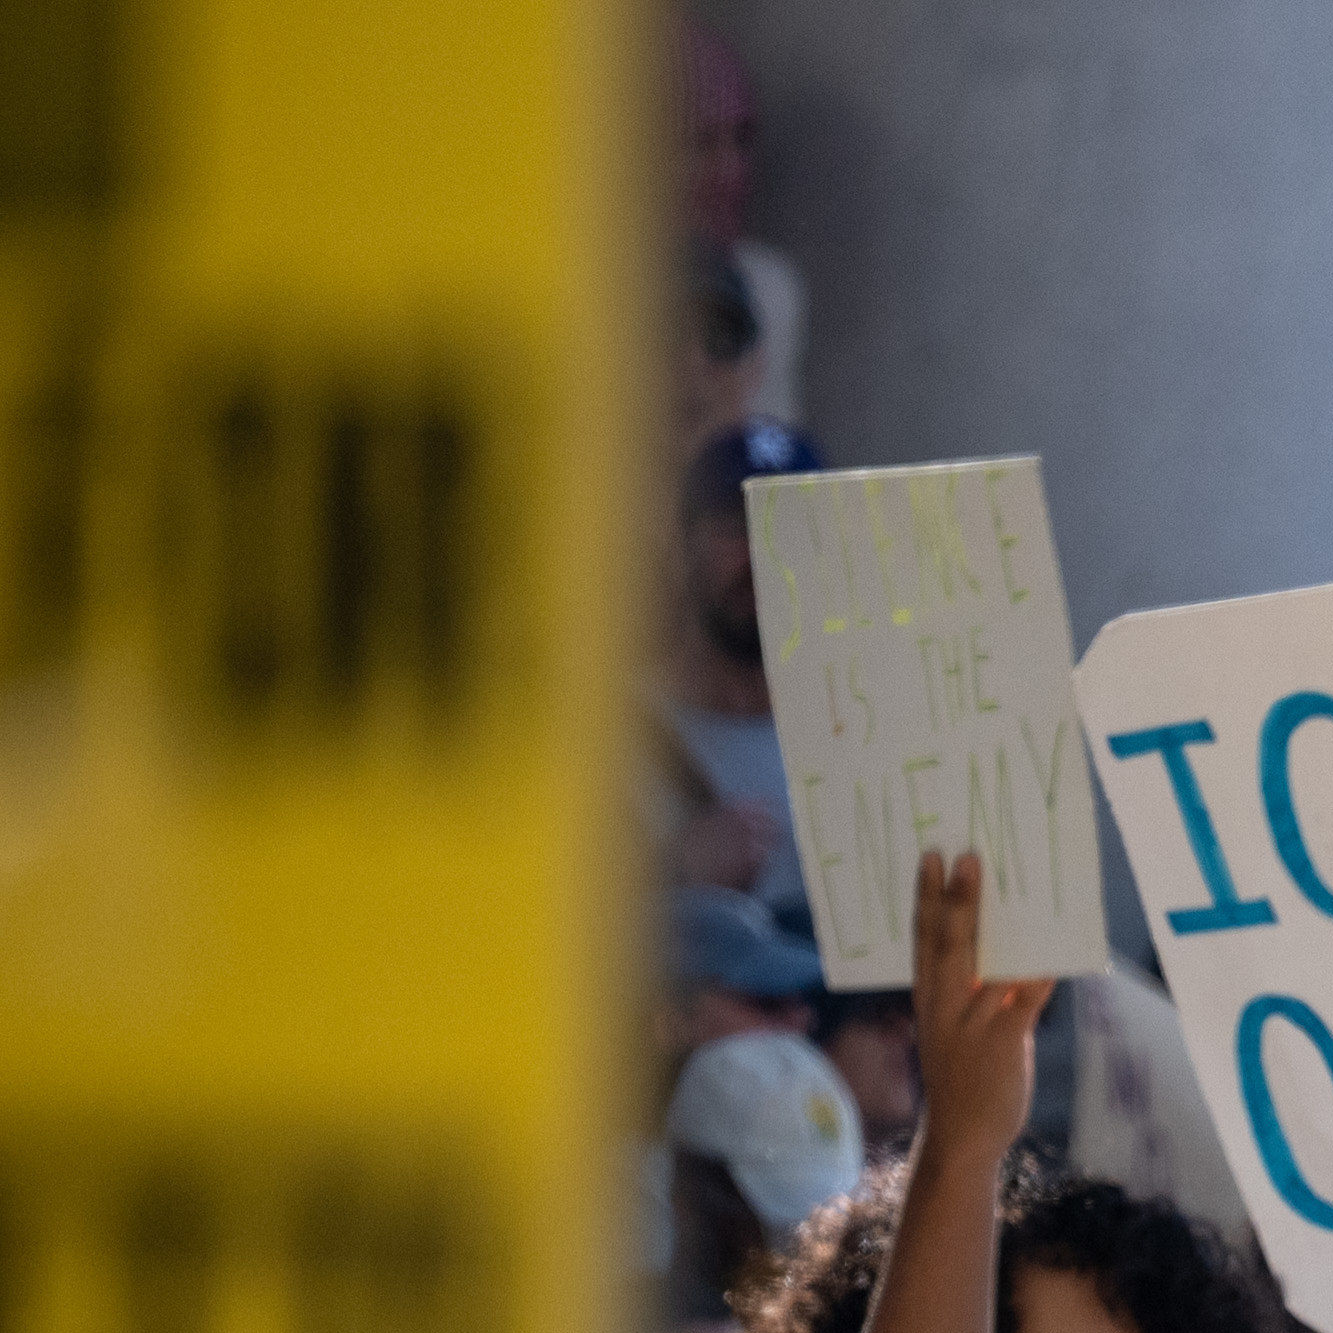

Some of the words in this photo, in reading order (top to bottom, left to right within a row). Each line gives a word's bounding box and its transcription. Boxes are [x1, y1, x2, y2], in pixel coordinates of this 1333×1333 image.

[825, 653, 876, 744] IS
[916, 625, 1000, 732] THE
[804, 717, 1068, 959] ENEMY
